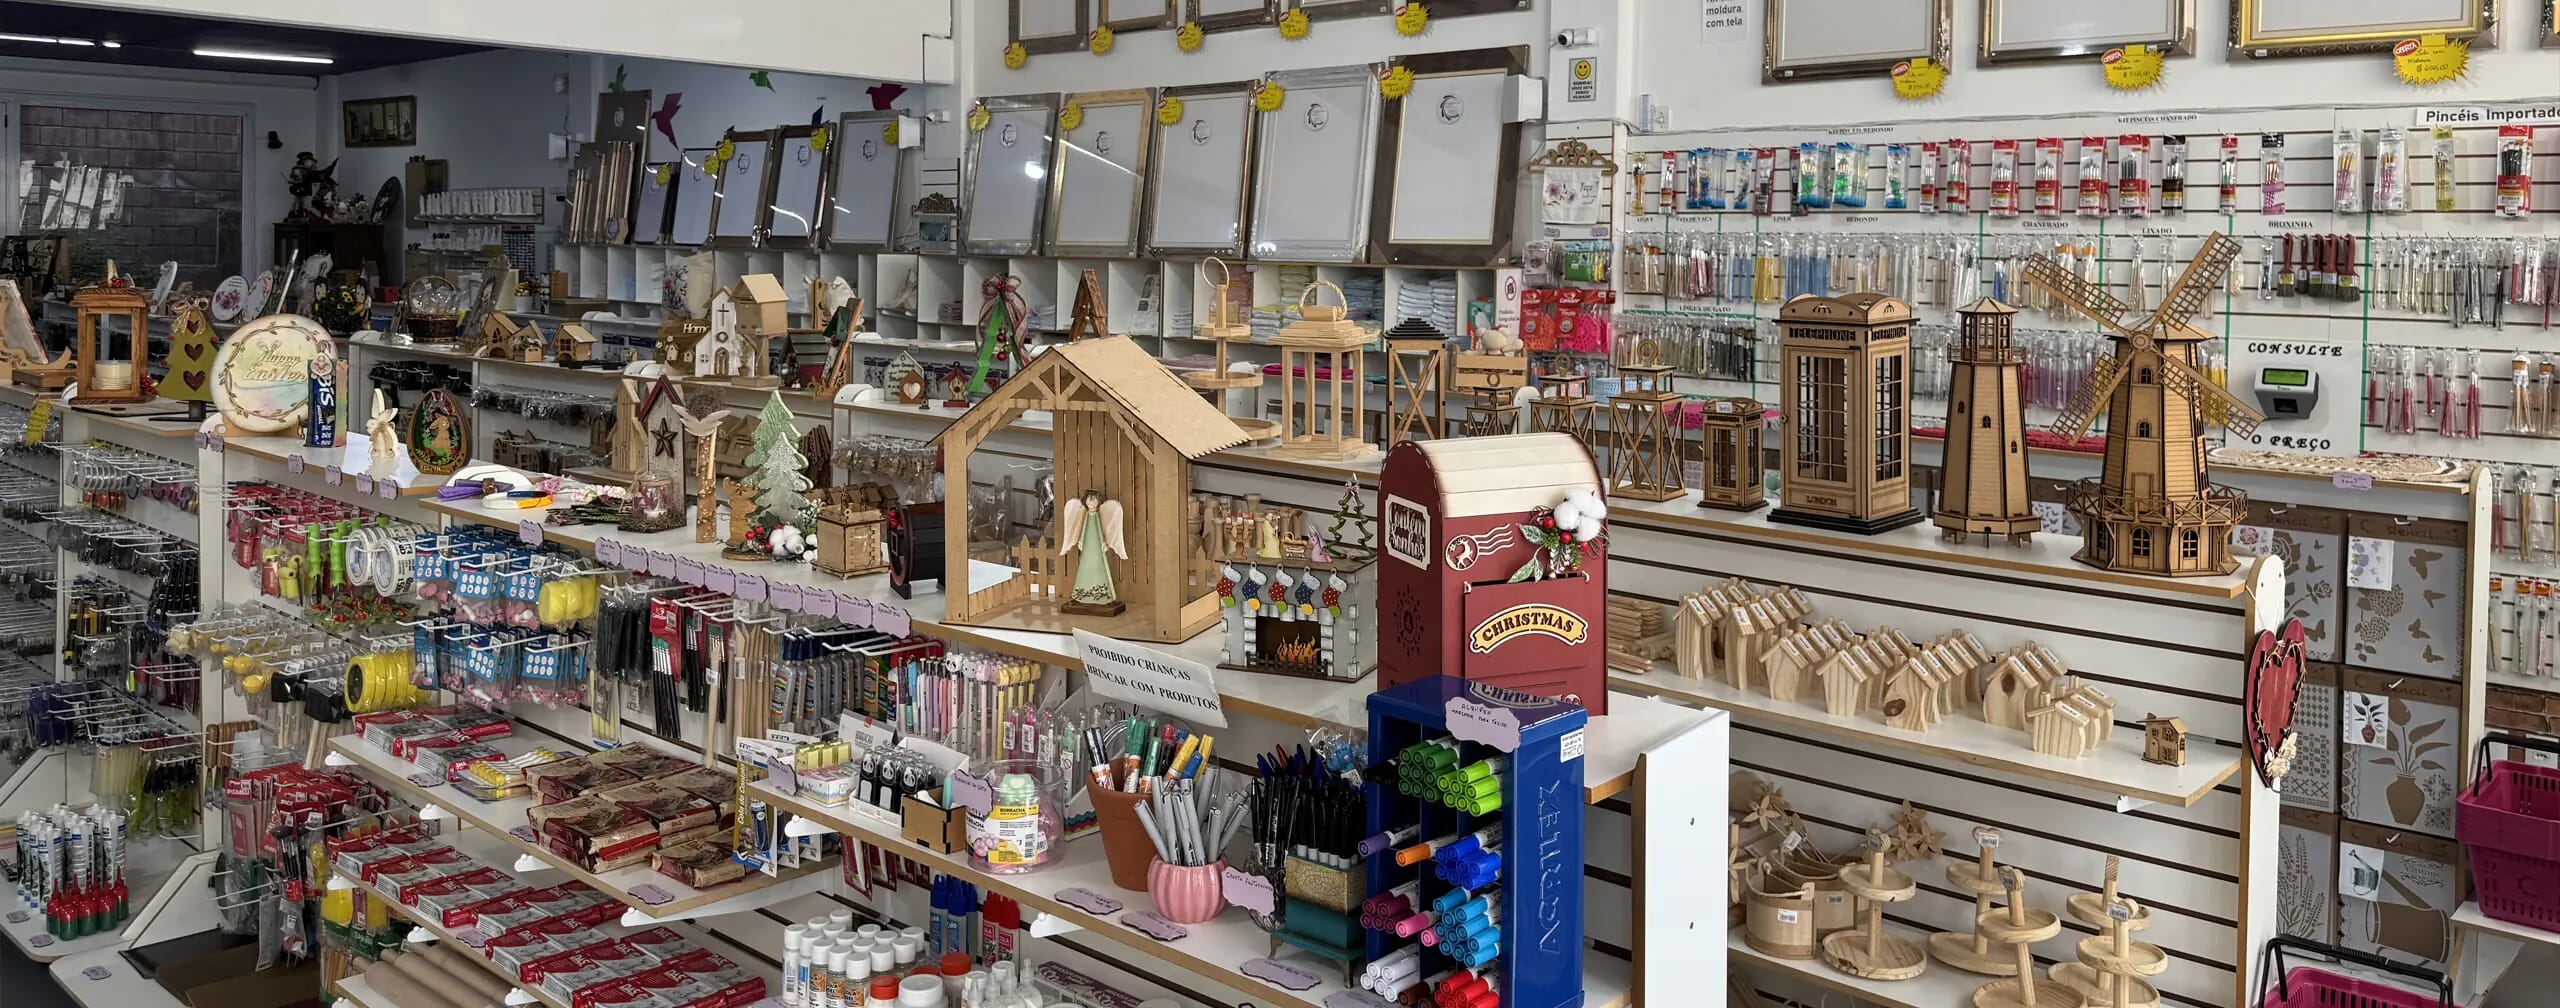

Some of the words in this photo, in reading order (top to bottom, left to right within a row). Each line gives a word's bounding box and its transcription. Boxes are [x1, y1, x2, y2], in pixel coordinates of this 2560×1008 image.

[1706, 5, 1742, 16] moldura
[1706, 19, 1724, 28] com
[1726, 17, 1743, 26] tela
[2395, 42, 2418, 54] OFERTA
[2426, 110, 2480, 122] Pincéis
[1846, 216, 1879, 224] REDONDO
[2022, 221, 2069, 229] CHANFRADO
[2268, 220, 2314, 229] BROXINHA
[2141, 227, 2173, 235] LIXADO
[683, 323, 708, 334] Hom
[1789, 327, 1856, 341] TELEPHONE
[1871, 326, 1907, 341] TELEPHONE
[255, 340, 302, 366] Happy
[2248, 342, 2343, 357] CONSULTE
[2251, 434, 2262, 445] O
[2270, 435, 2331, 451] PREÇO
[1807, 496, 1838, 507] LONDON
[1389, 505, 1426, 536] Contém
[2386, 526, 2433, 540] stencil
[1389, 525, 1426, 561] Sonhos
[1482, 611, 1574, 642] CHRISTMAS
[1088, 644, 1136, 667] PROIBIDO
[1137, 657, 1191, 682] CRIANÇAS
[1086, 663, 1128, 688] BRINCAR
[1130, 679, 1156, 696] COM
[1158, 686, 1218, 711] PRODUTOS
[737, 806, 745, 825] Cola
[1537, 779, 1561, 954] ACRILEX
[567, 917, 582, 930] DAS
[653, 926, 672, 939] DAS
[615, 942, 631, 955] DAS
[571, 953, 591, 966] DAS
[709, 952, 726, 964] DAS
[667, 969, 686, 981] DAS
[622, 983, 641, 997] DAS
